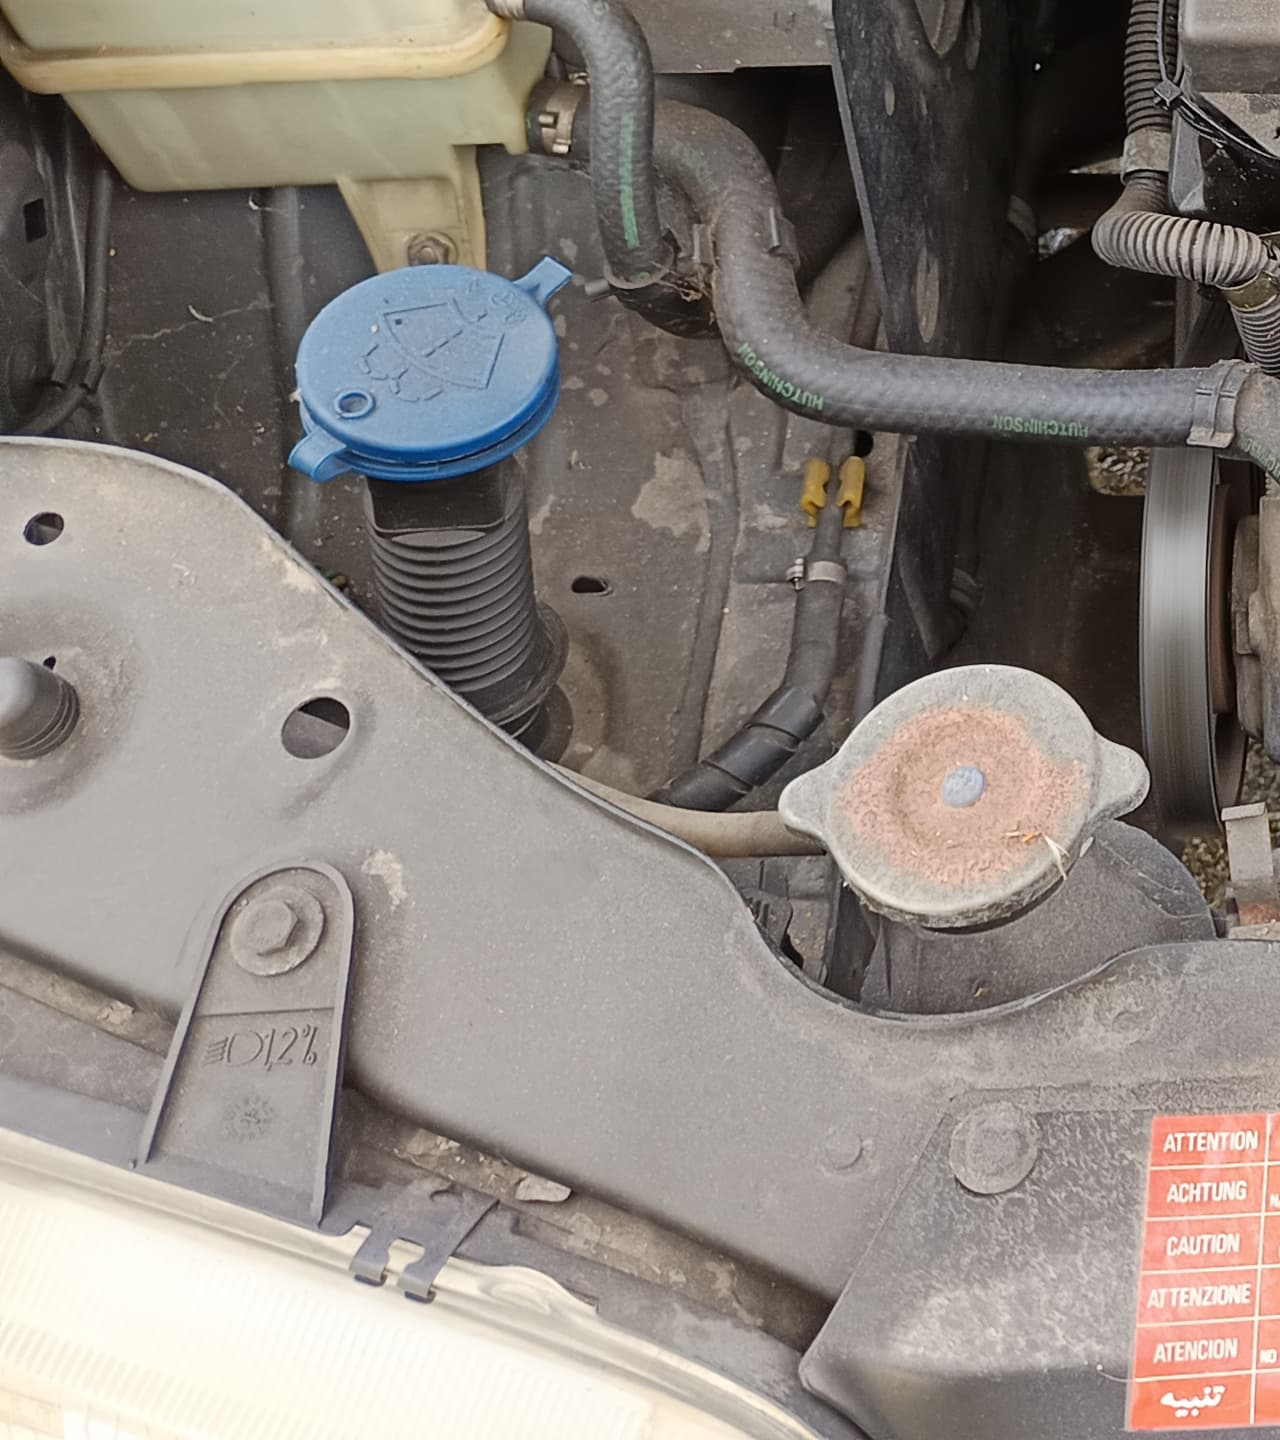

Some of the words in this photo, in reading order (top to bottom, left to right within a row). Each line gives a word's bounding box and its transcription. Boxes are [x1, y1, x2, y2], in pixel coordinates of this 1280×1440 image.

[737, 342, 824, 411] HUTCHINSON
[991, 414, 1089, 439] HUTCHINSON
[1163, 1130, 1258, 1153] ATTENTION
[1166, 1180, 1247, 1203] ACHTUNG
[1165, 1233, 1240, 1257] CAUTION
[1146, 1283, 1251, 1309] ATTENZIONE
[1152, 1337, 1238, 1364] ATENCION
[1159, 1385, 1226, 1419] تنبيه
